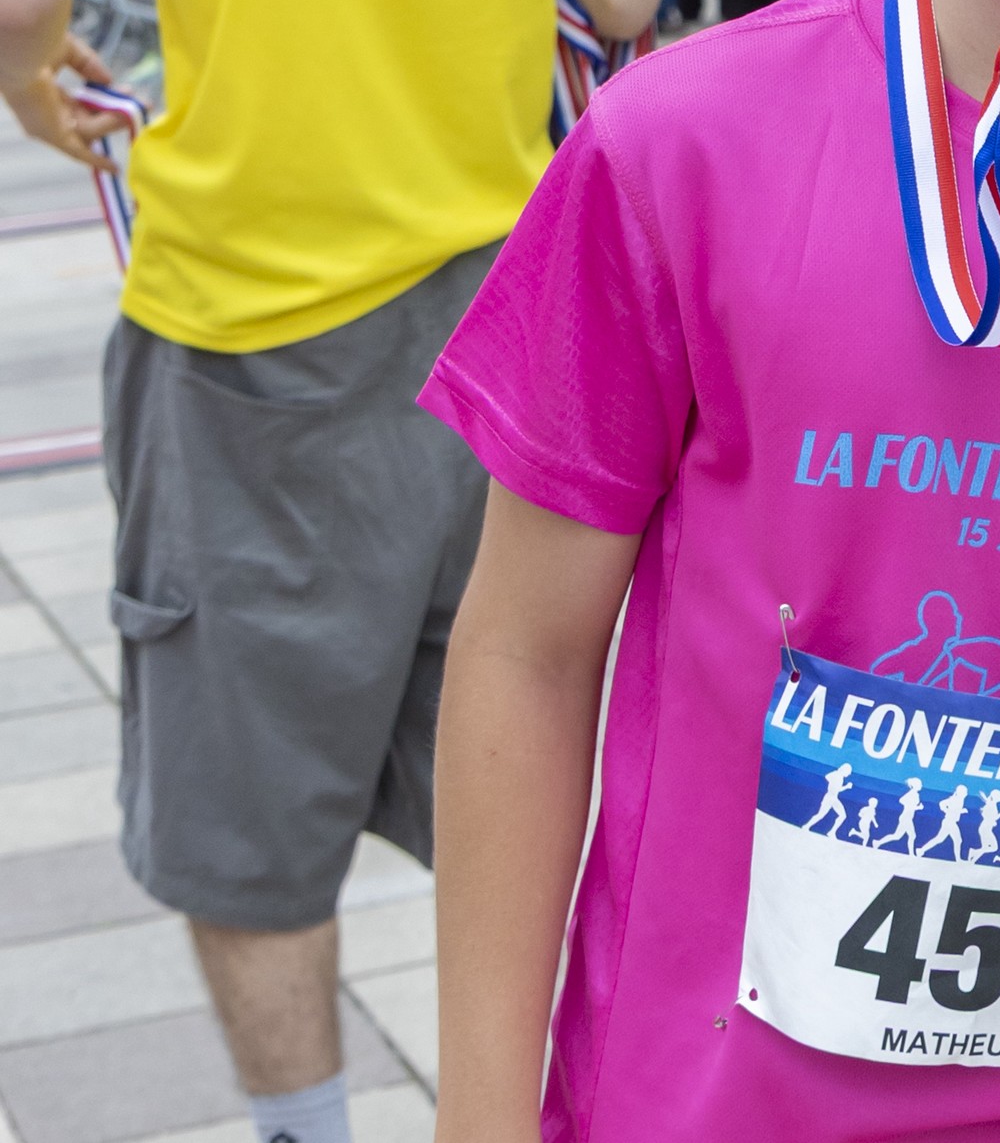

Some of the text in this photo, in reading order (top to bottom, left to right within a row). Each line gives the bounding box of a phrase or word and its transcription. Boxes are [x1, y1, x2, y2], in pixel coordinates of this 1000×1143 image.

[795, 429, 853, 488] LA
[958, 517, 991, 548] 15
[770, 679, 827, 742] LA
